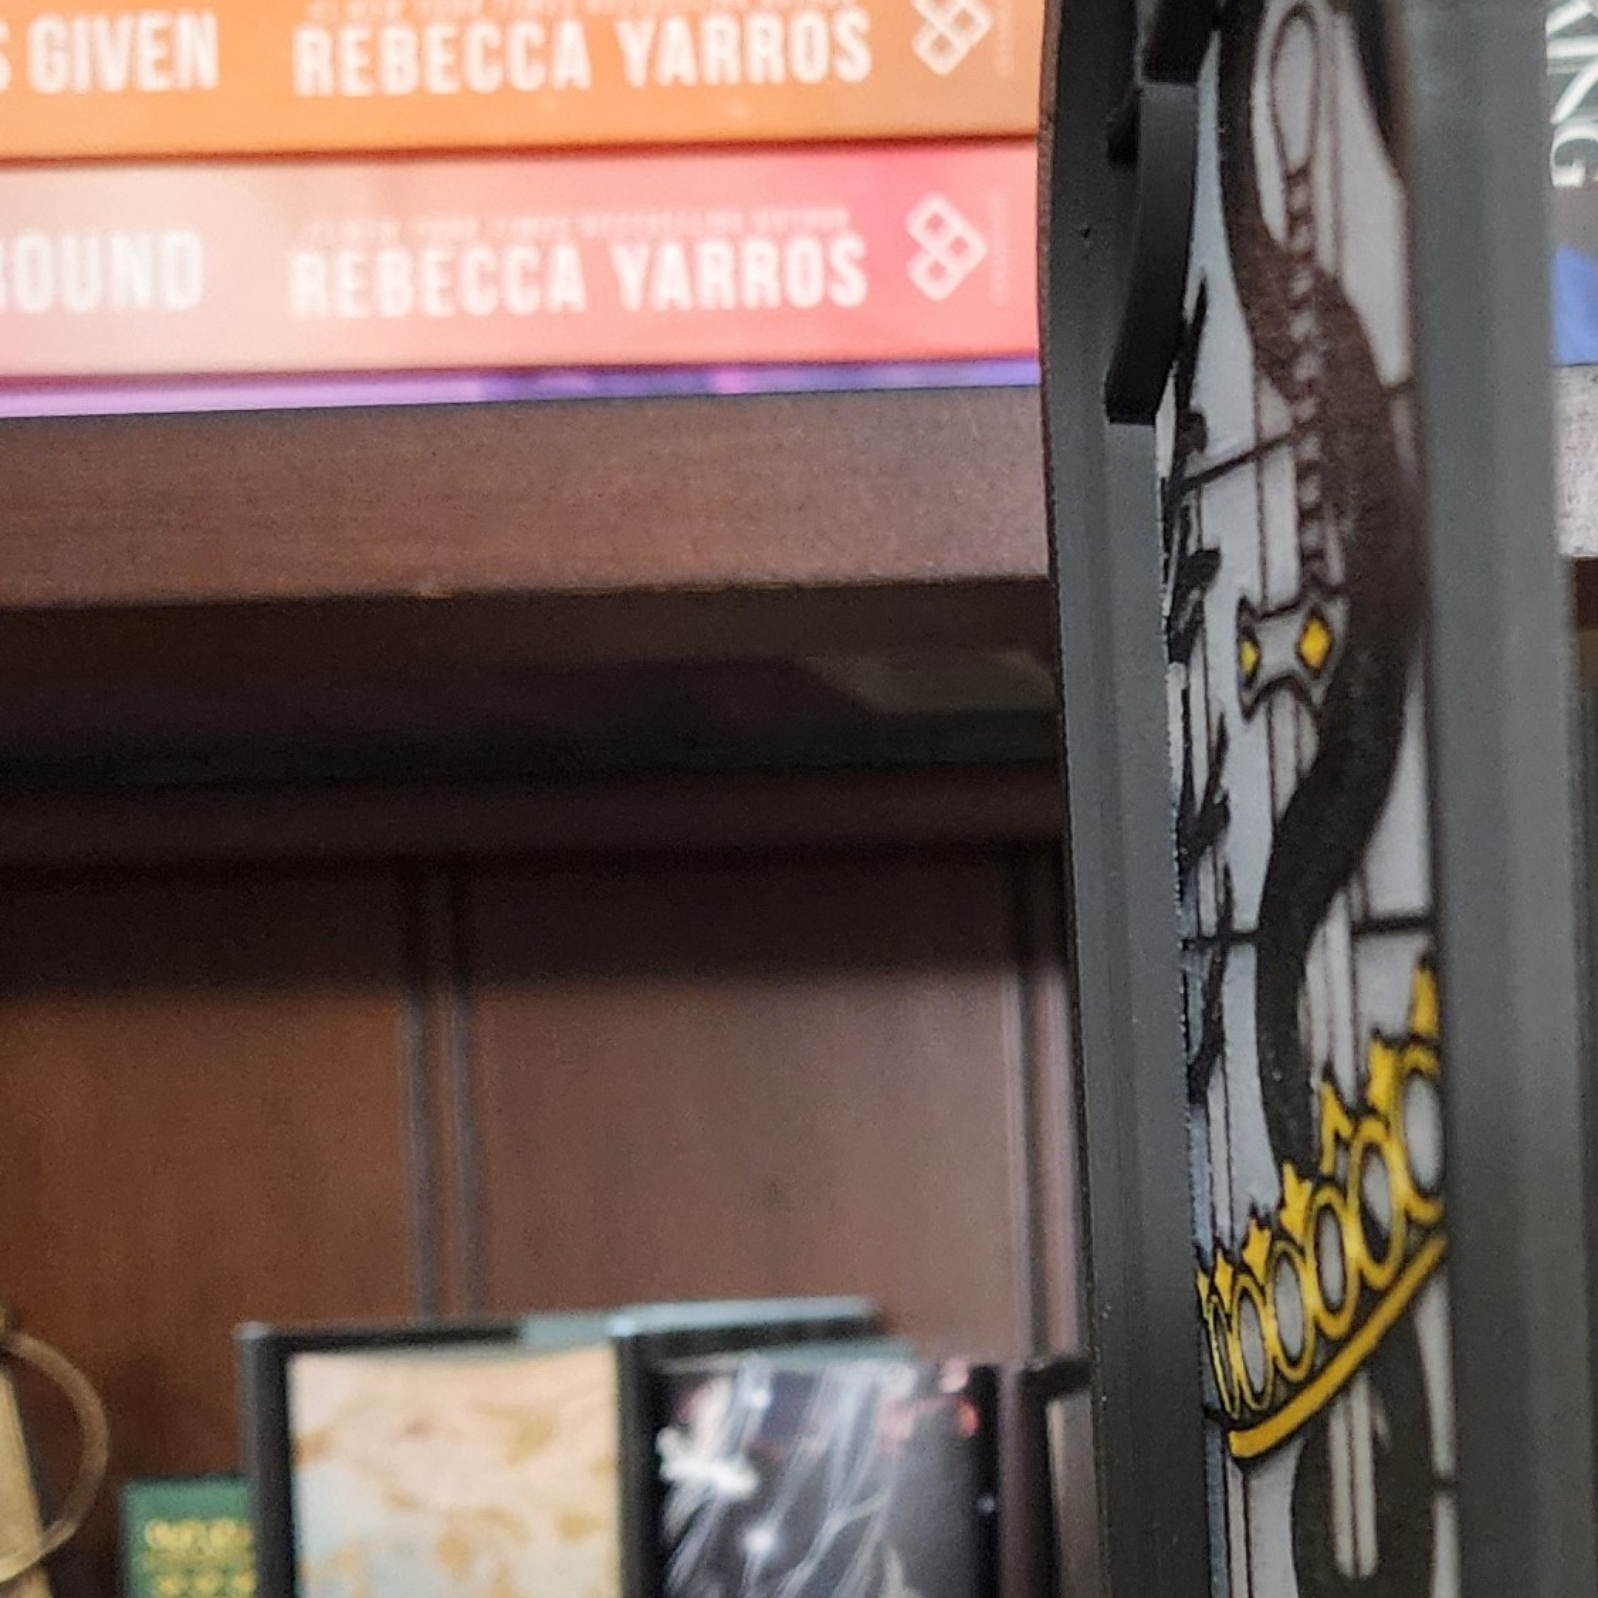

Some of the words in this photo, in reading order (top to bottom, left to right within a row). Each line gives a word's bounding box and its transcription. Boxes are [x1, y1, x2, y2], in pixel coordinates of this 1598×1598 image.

[27, 11, 219, 94] GIVEN
[291, 18, 593, 97] REBECCA
[613, 7, 873, 86] YARROS
[0, 228, 206, 315] OUND
[289, 237, 589, 319] REBECCA
[610, 232, 868, 313] YARROS
